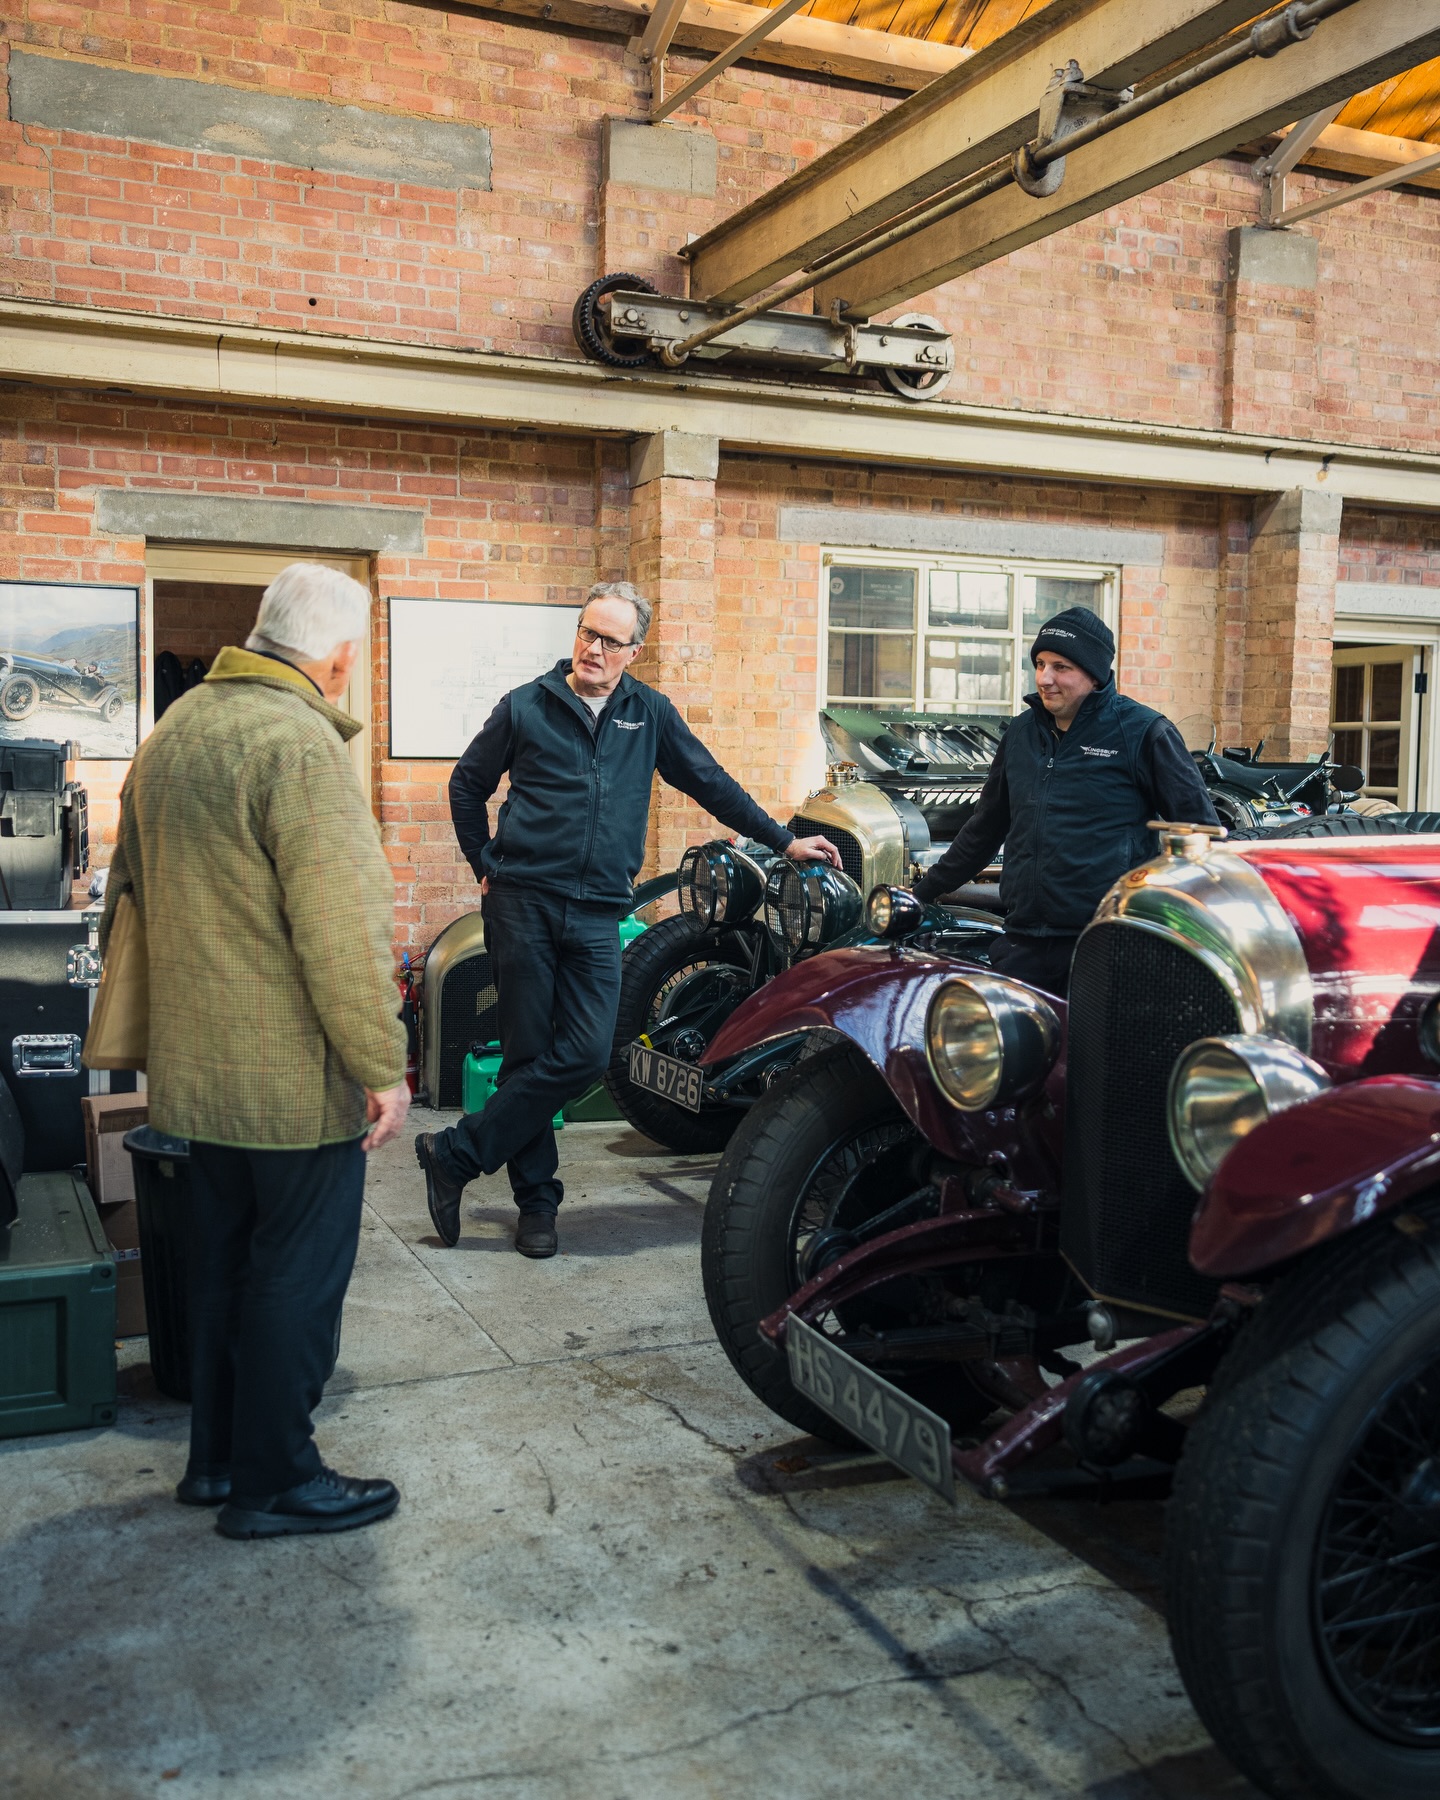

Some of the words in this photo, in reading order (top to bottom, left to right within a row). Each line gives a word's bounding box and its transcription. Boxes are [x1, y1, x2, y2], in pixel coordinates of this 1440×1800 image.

[631, 1047, 652, 1084] KW
[656, 1058, 699, 1106] 8726
[794, 1328, 836, 1408] HS
[842, 1371, 943, 1484] 4479
